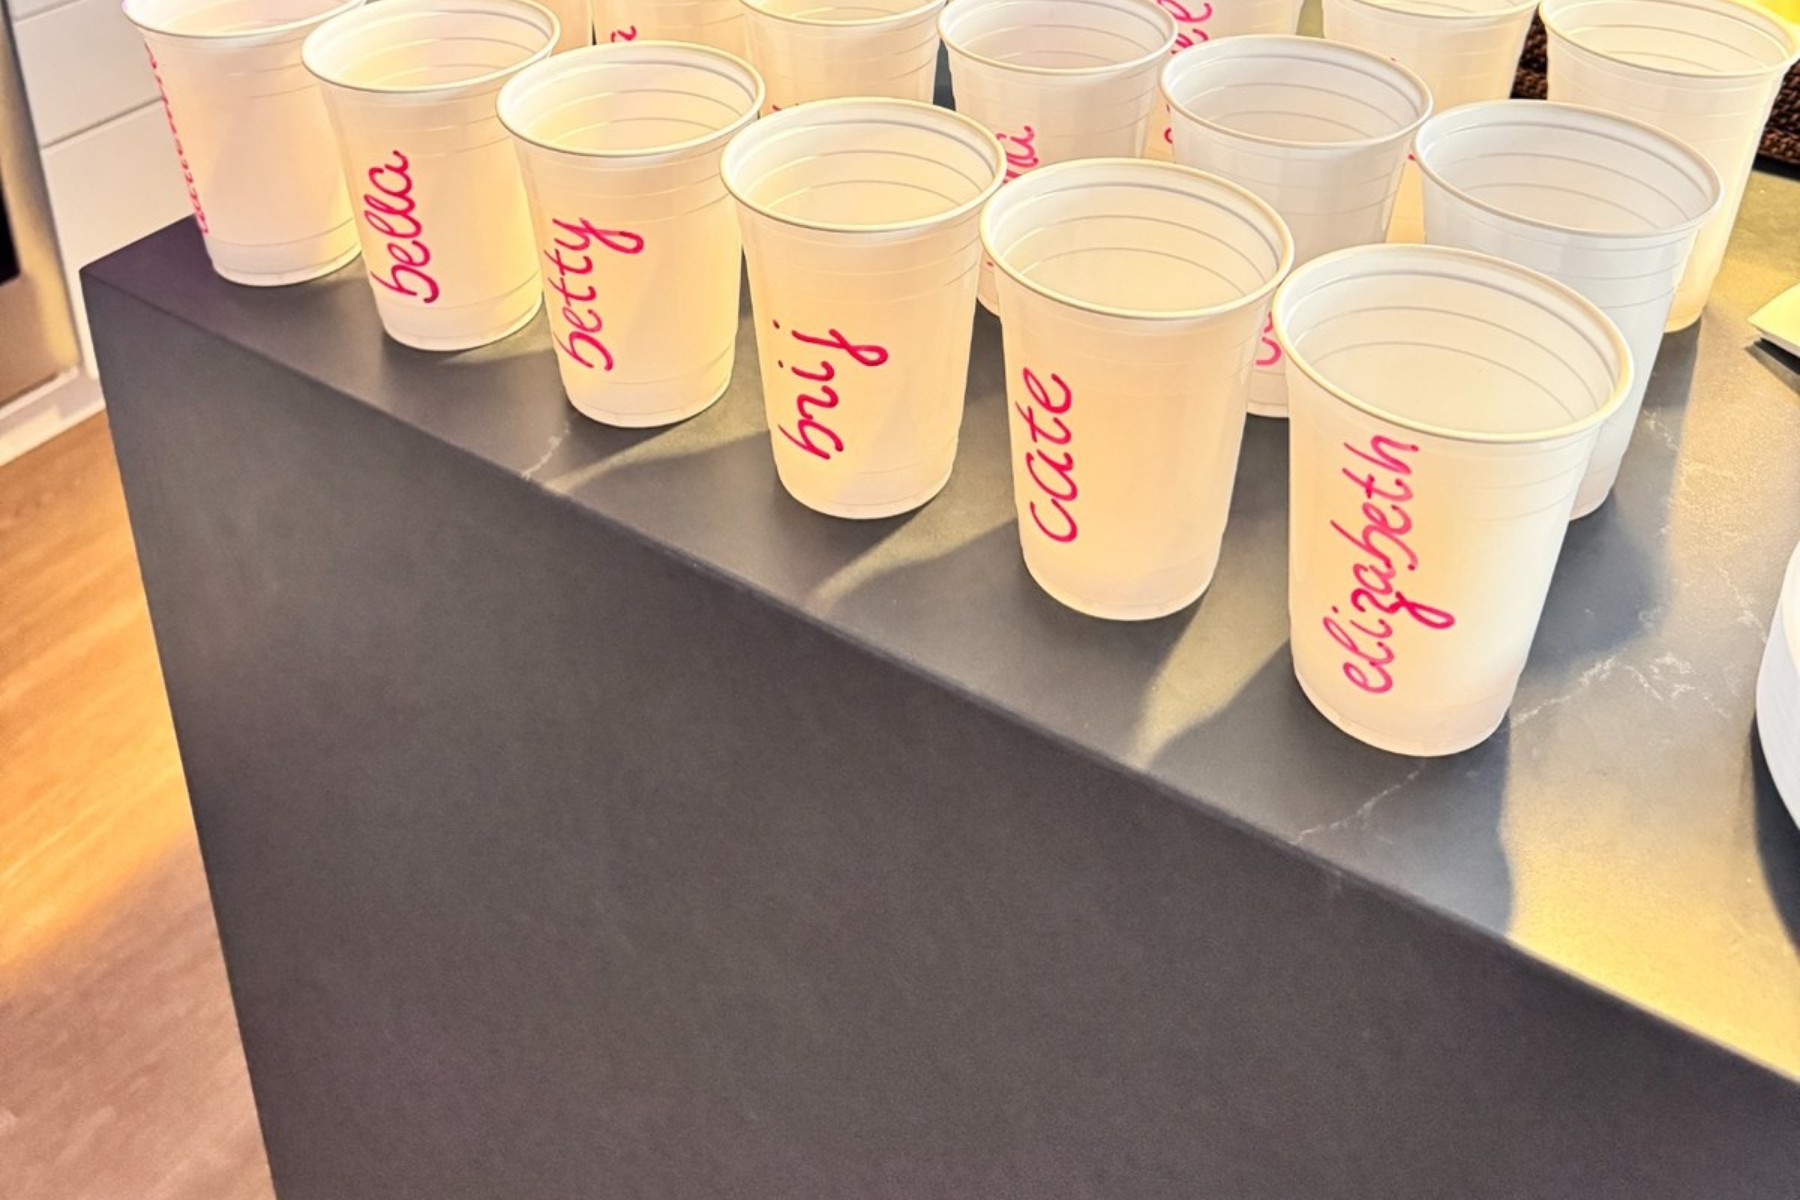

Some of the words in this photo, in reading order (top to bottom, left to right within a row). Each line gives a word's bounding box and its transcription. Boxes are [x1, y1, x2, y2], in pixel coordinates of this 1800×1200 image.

[365, 151, 440, 304] bella
[544, 218, 644, 372] betty
[773, 319, 888, 460] brij
[1015, 367, 1078, 544] cate
[1322, 435, 1455, 694] elizabeth
